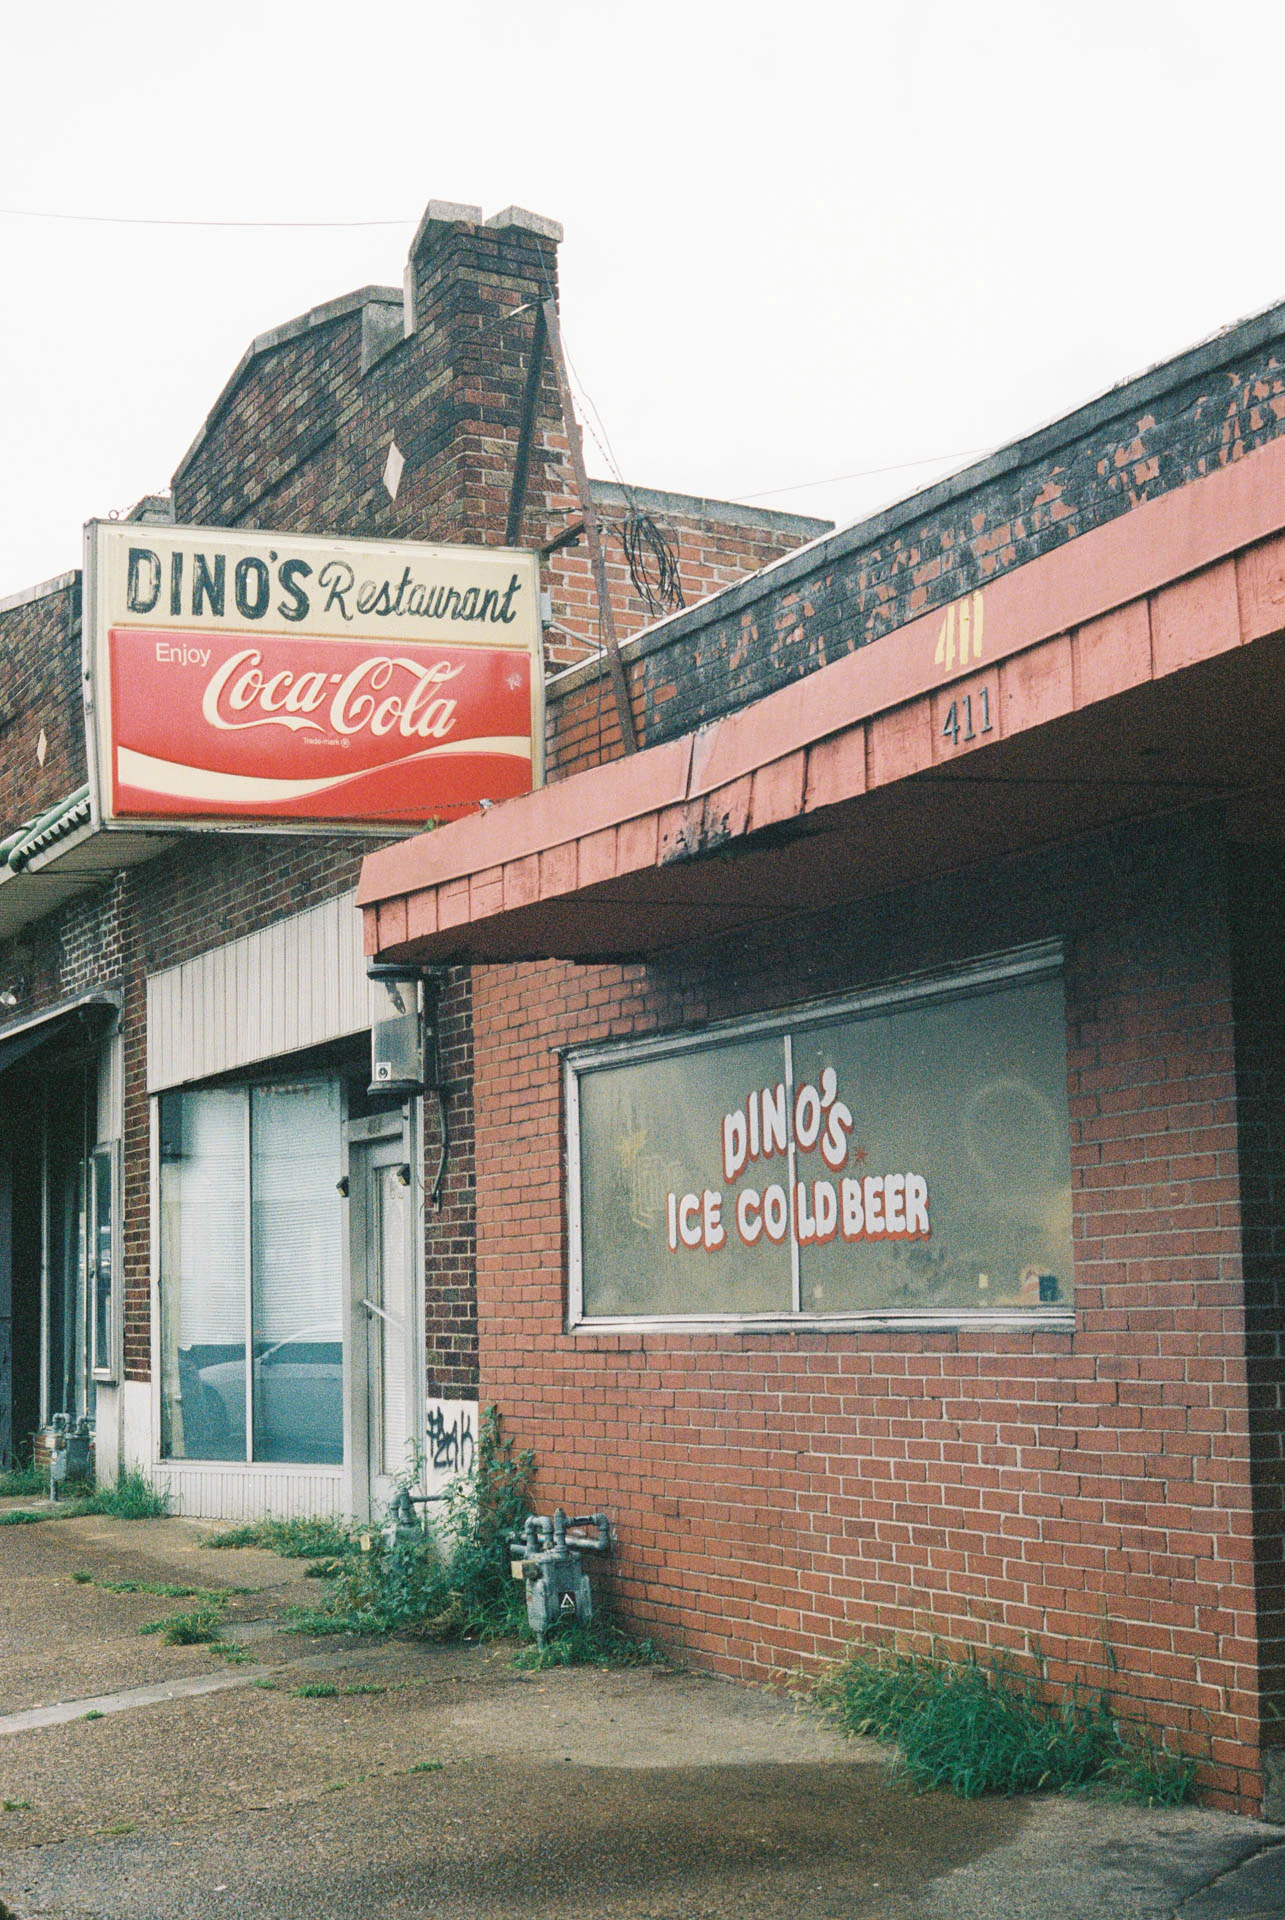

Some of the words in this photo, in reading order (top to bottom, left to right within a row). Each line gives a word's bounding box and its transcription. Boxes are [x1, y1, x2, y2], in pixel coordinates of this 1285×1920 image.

[127, 547, 312, 622] DINO'S
[318, 559, 522, 624] Restaurant
[155, 642, 212, 668] Enjoy
[202, 648, 466, 738] Coca-Cola
[942, 686, 993, 745] 411
[722, 1066, 853, 1183] DINO'S
[666, 1190, 725, 1253] ICE
[737, 1181, 837, 1246] COLD
[840, 1172, 930, 1242] BEER
